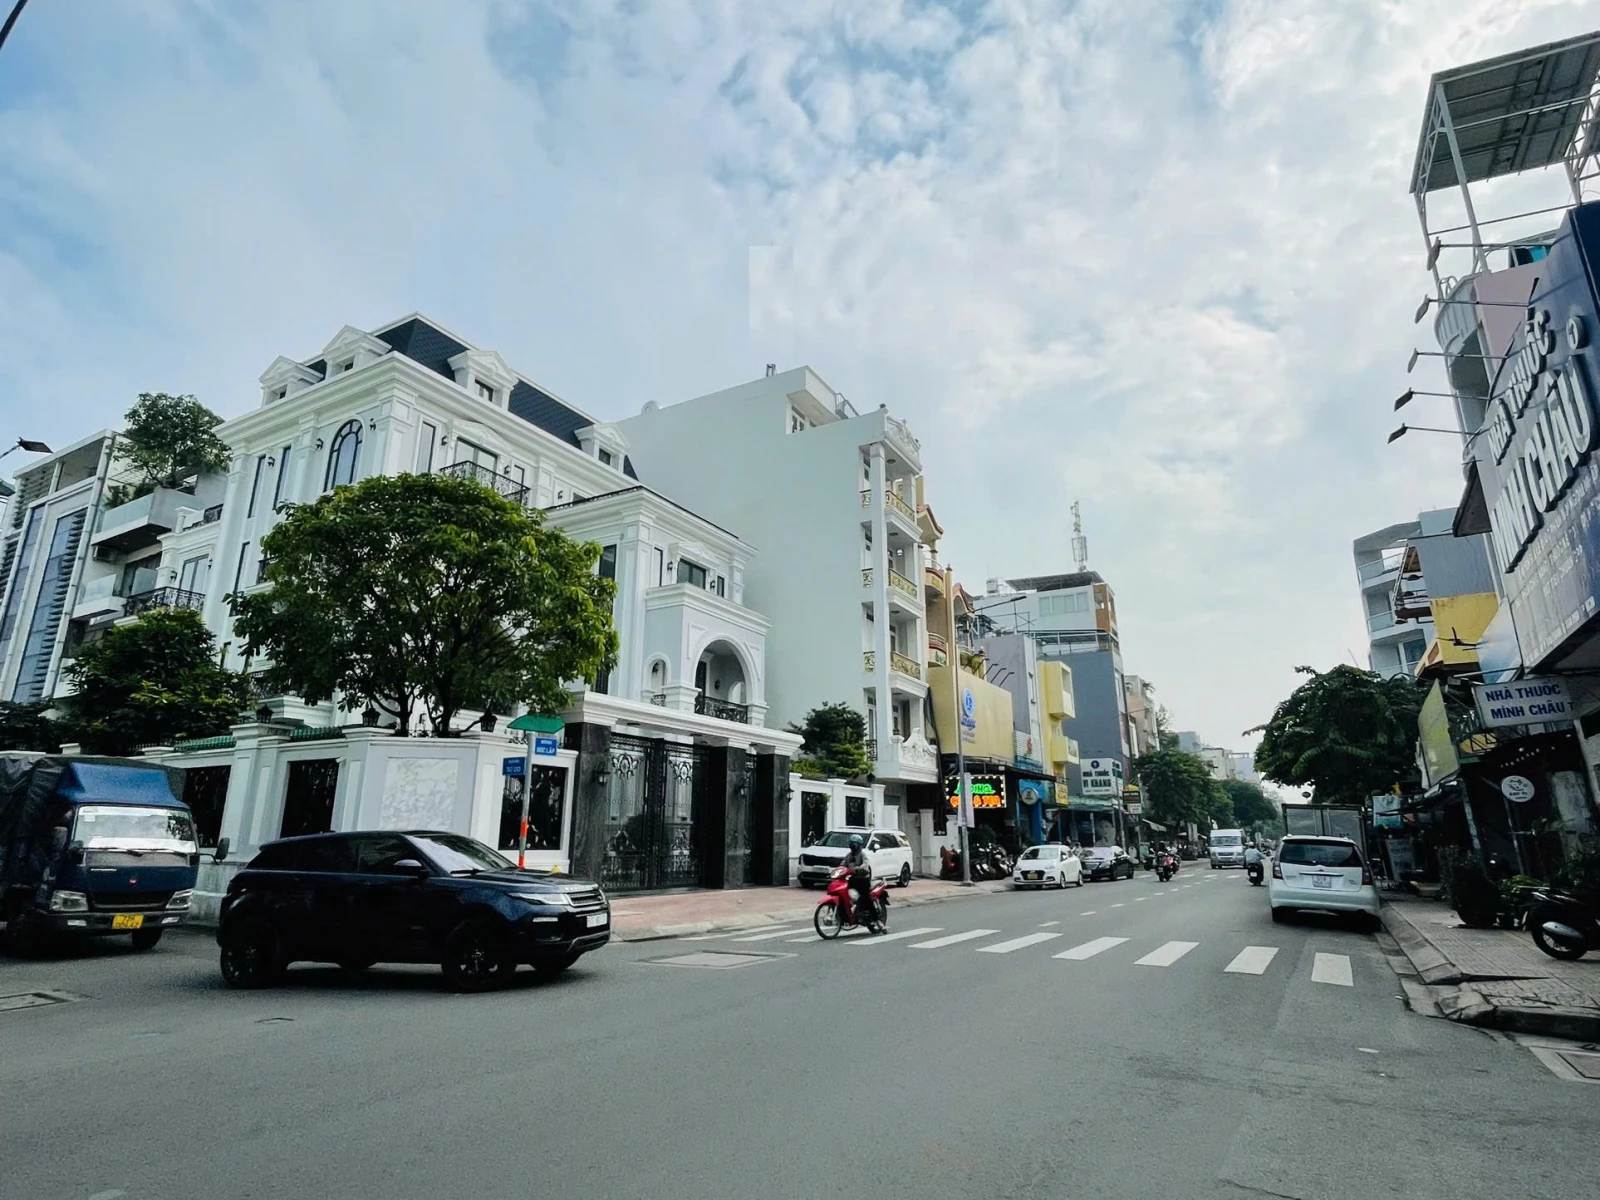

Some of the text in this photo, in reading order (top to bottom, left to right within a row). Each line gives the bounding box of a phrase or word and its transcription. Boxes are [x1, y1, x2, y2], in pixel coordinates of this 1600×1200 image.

[1487, 397, 1514, 465] NHÀ
[1491, 457, 1537, 573] MINH
[1524, 354, 1591, 513] CHÂU
[1485, 686, 1513, 701] NHÀ
[1529, 700, 1566, 715] CHÂU
